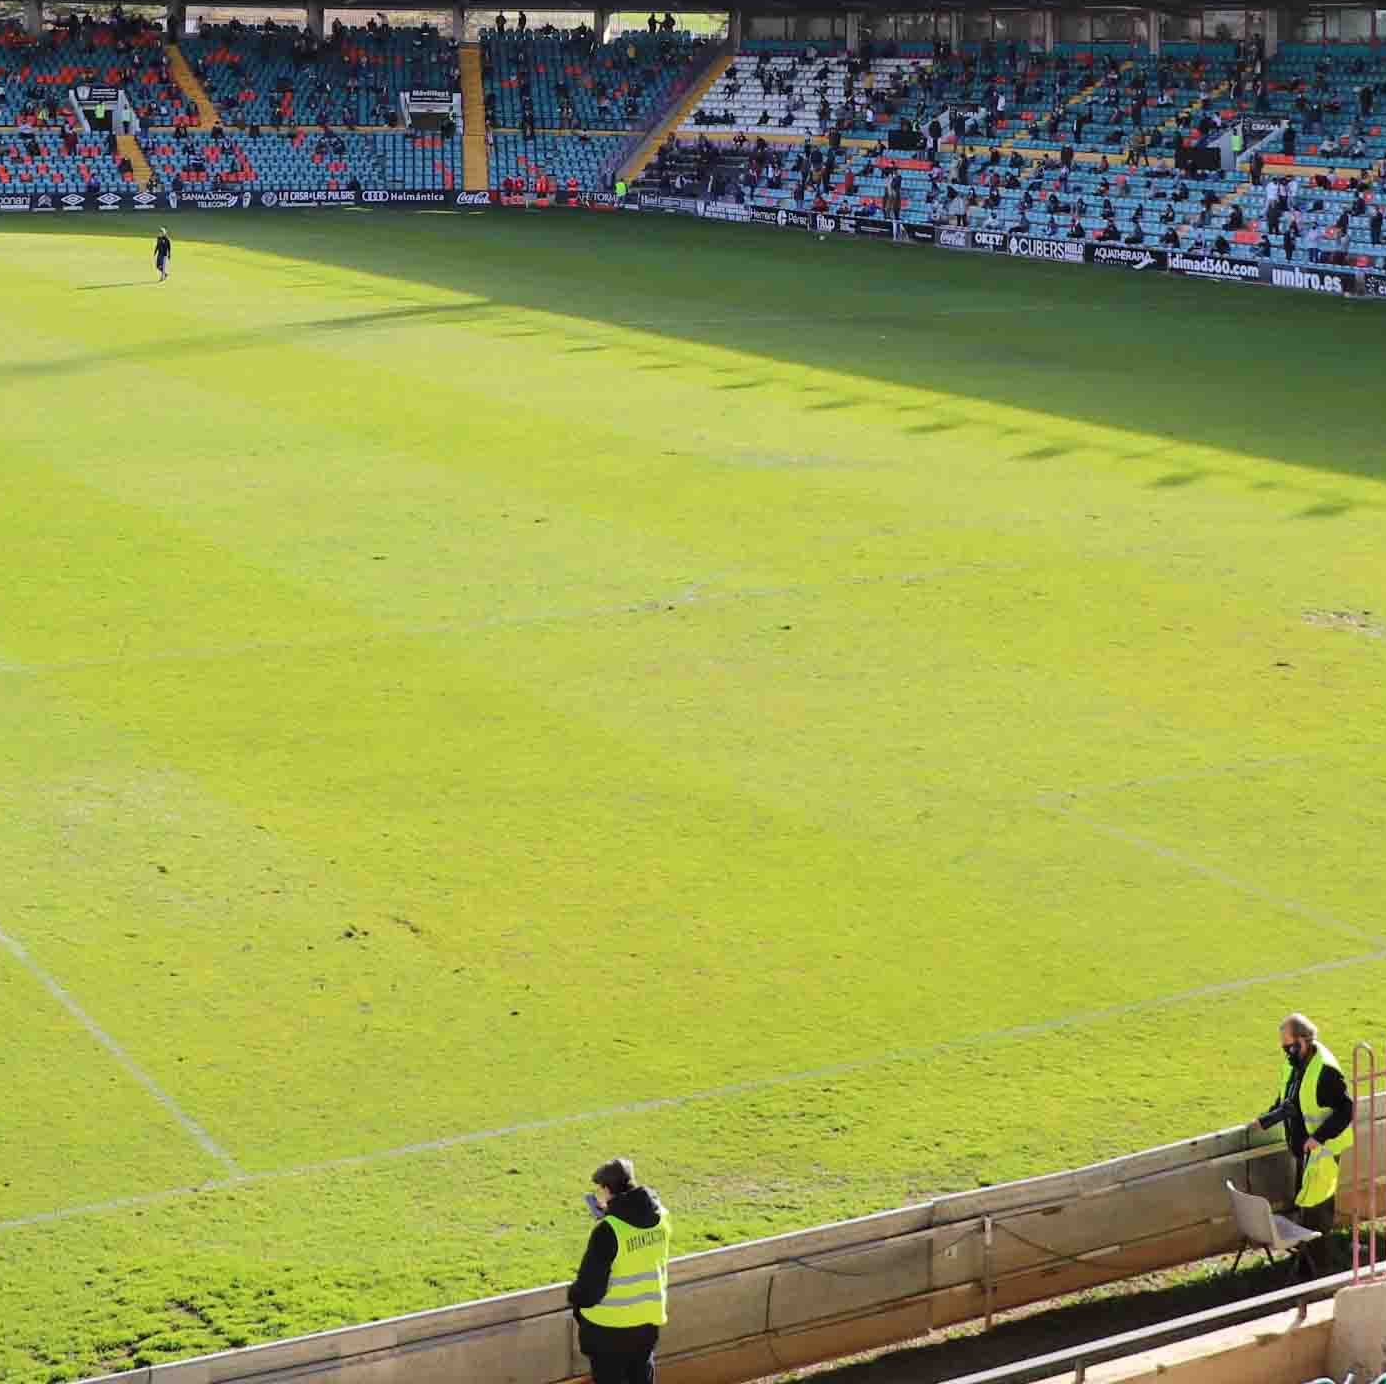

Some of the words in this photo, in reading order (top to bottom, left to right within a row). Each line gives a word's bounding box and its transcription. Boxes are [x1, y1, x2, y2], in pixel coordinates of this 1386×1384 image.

[750, 208, 777, 222] Herrero
[975, 233, 1004, 246] OKEY!
[1018, 237, 1065, 259] CUBERS
[1168, 252, 1260, 277] idimad360.com
[1272, 267, 1342, 292] umbro.es
